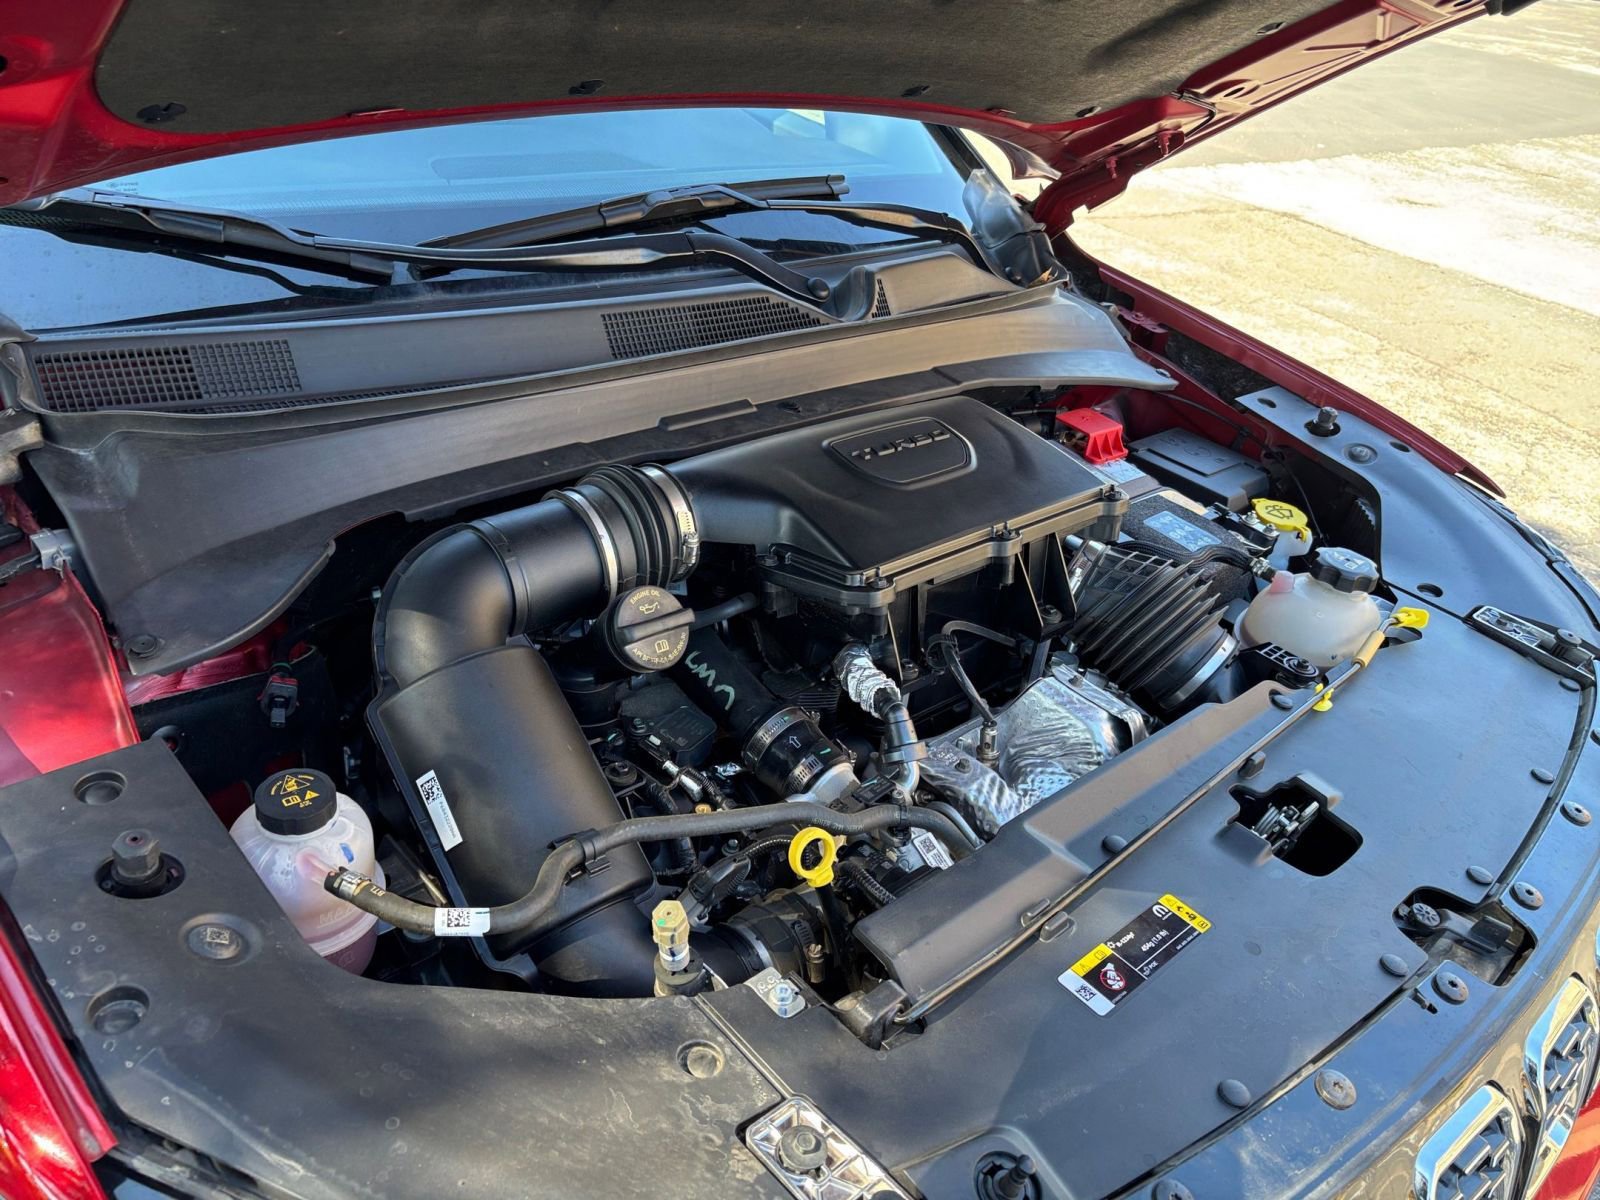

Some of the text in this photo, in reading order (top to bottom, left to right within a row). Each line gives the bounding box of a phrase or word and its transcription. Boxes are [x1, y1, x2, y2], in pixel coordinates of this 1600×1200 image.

[851, 430, 951, 460] TURBO
[630, 589, 660, 604] ENGINE OIL
[370, 885, 386, 896] BTL
